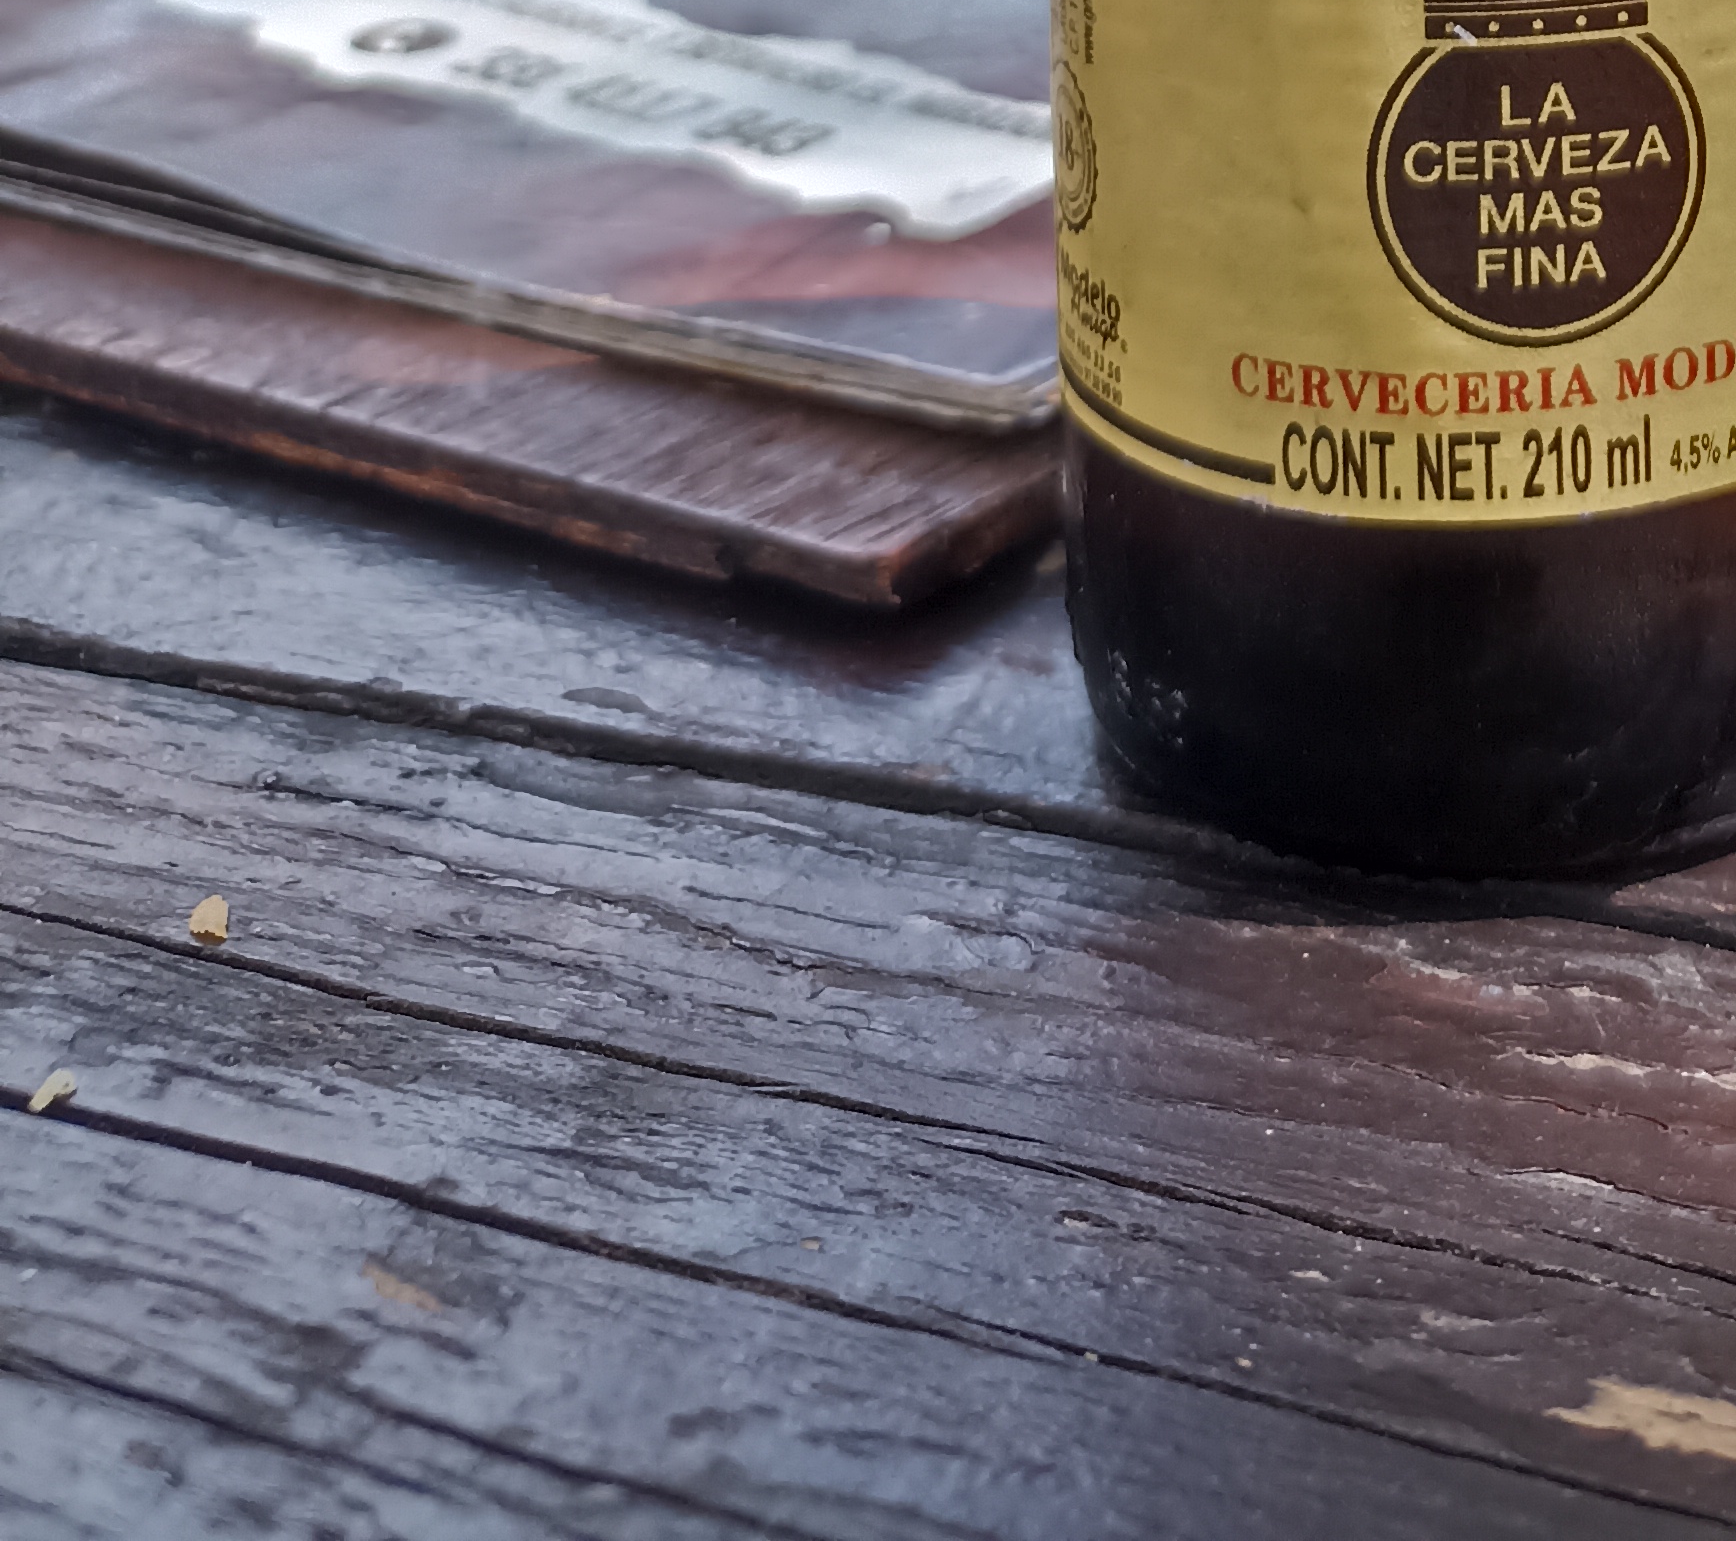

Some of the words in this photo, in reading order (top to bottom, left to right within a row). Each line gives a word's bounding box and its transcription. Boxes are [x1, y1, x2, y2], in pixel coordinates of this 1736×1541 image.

[1499, 81, 1578, 128] LA
[1402, 124, 1673, 185] CERVEZA
[1477, 186, 1605, 236] MAS
[1475, 242, 1608, 291] FINA
[1230, 351, 1597, 418] CERVECERIA
[1279, 419, 1404, 500] CONT.
[1415, 428, 1509, 501] NET.
[1521, 424, 1595, 498] 210
[1605, 416, 1654, 487] ml
